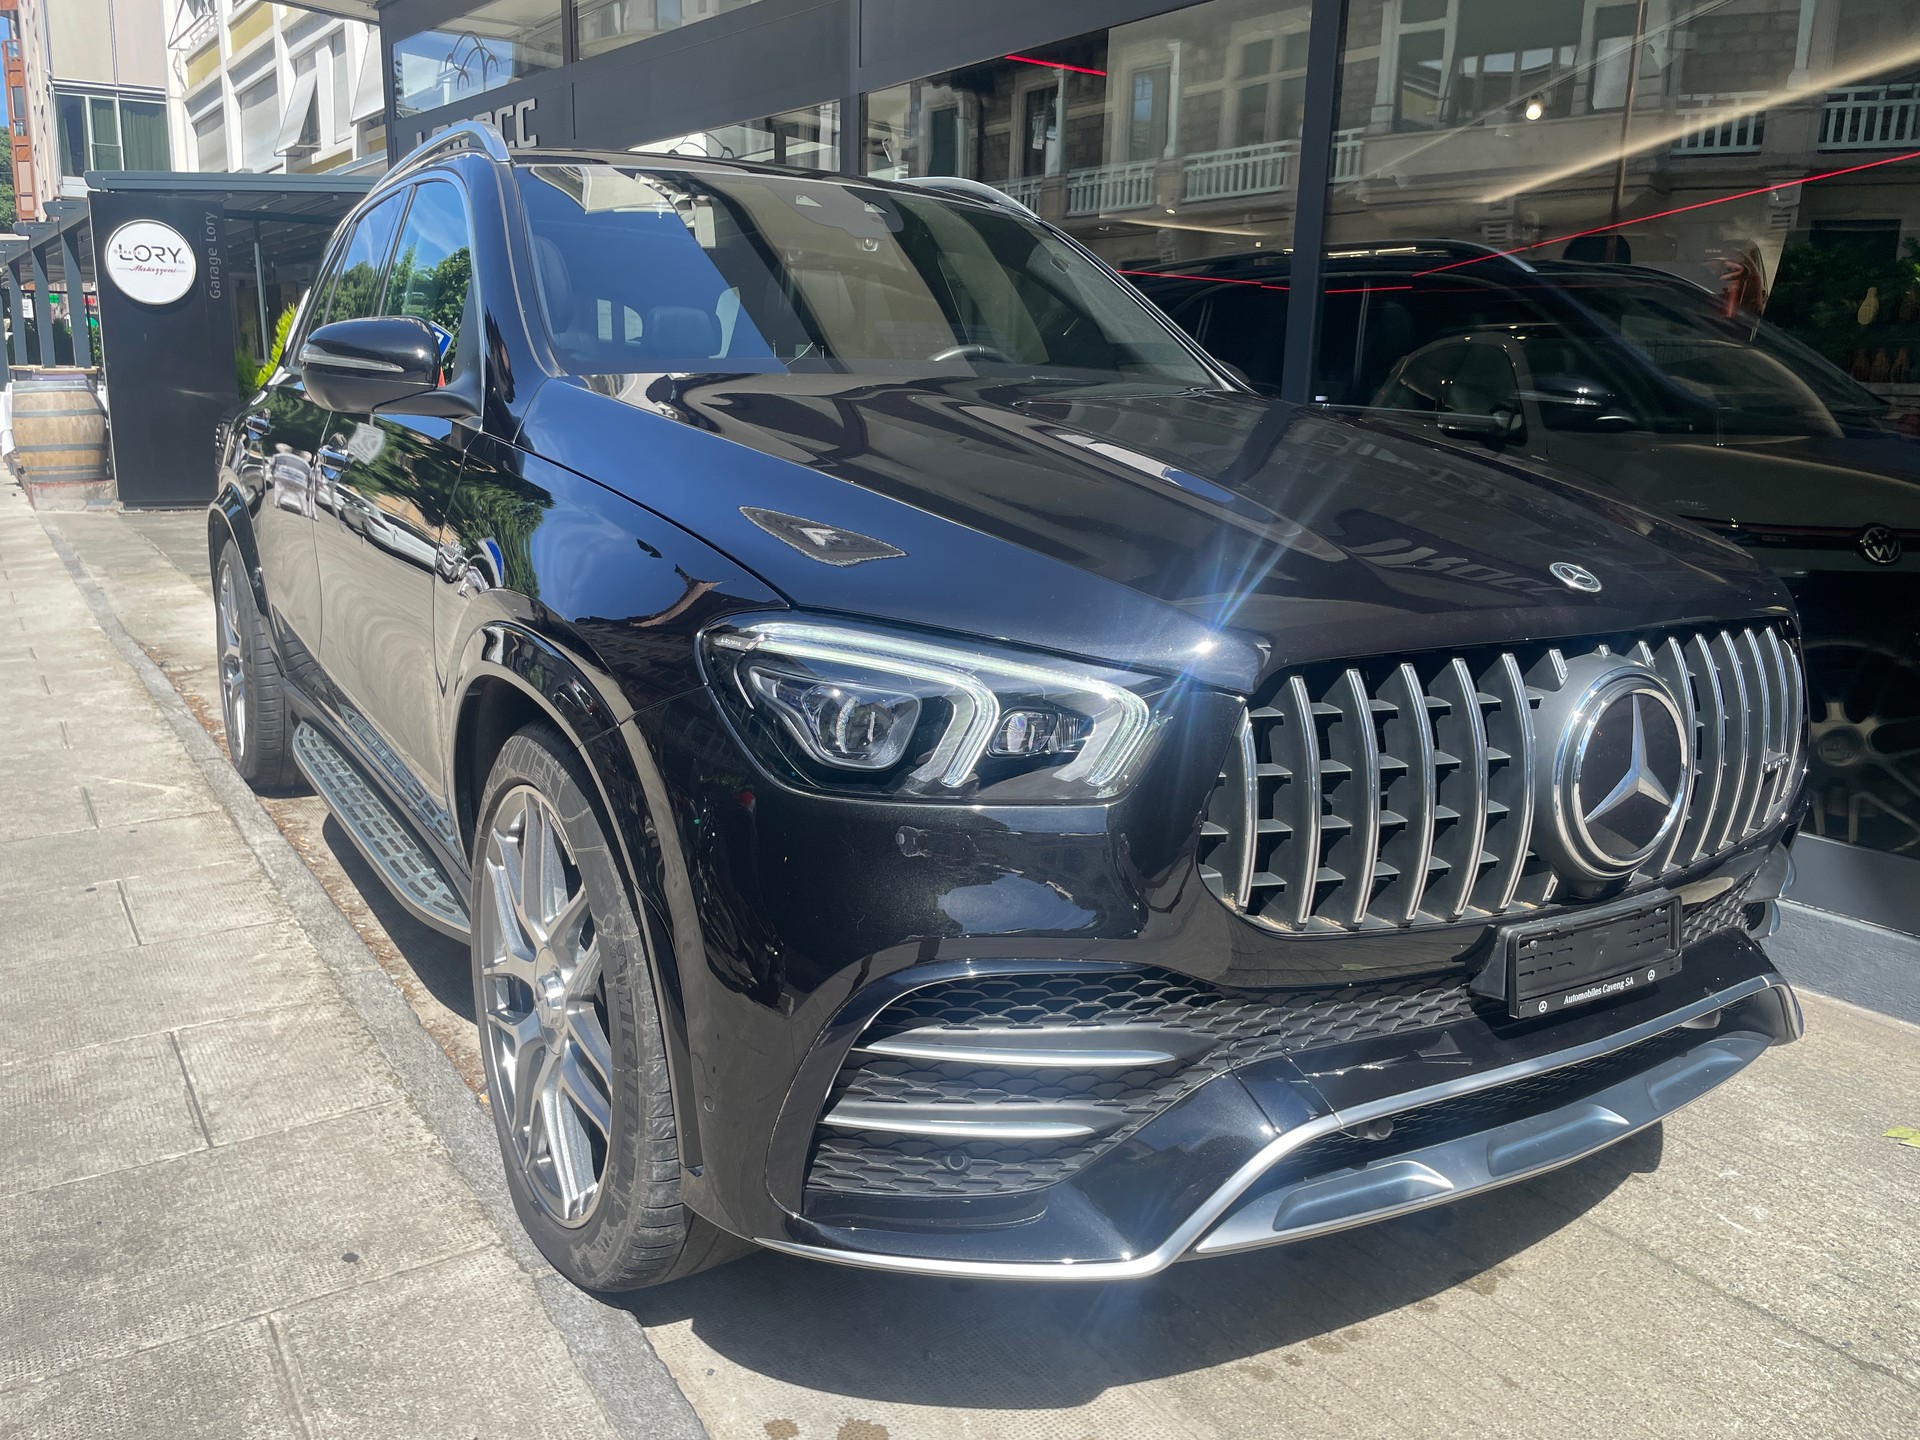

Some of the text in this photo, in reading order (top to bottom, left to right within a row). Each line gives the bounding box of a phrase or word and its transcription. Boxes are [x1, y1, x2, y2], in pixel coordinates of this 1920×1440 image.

[119, 244, 182, 264] LORY
[205, 211, 221, 299] Garage Lory
[1563, 976, 1634, 1004] Automobiles Caveng SA
[617, 985, 638, 1182] MICHELIN
